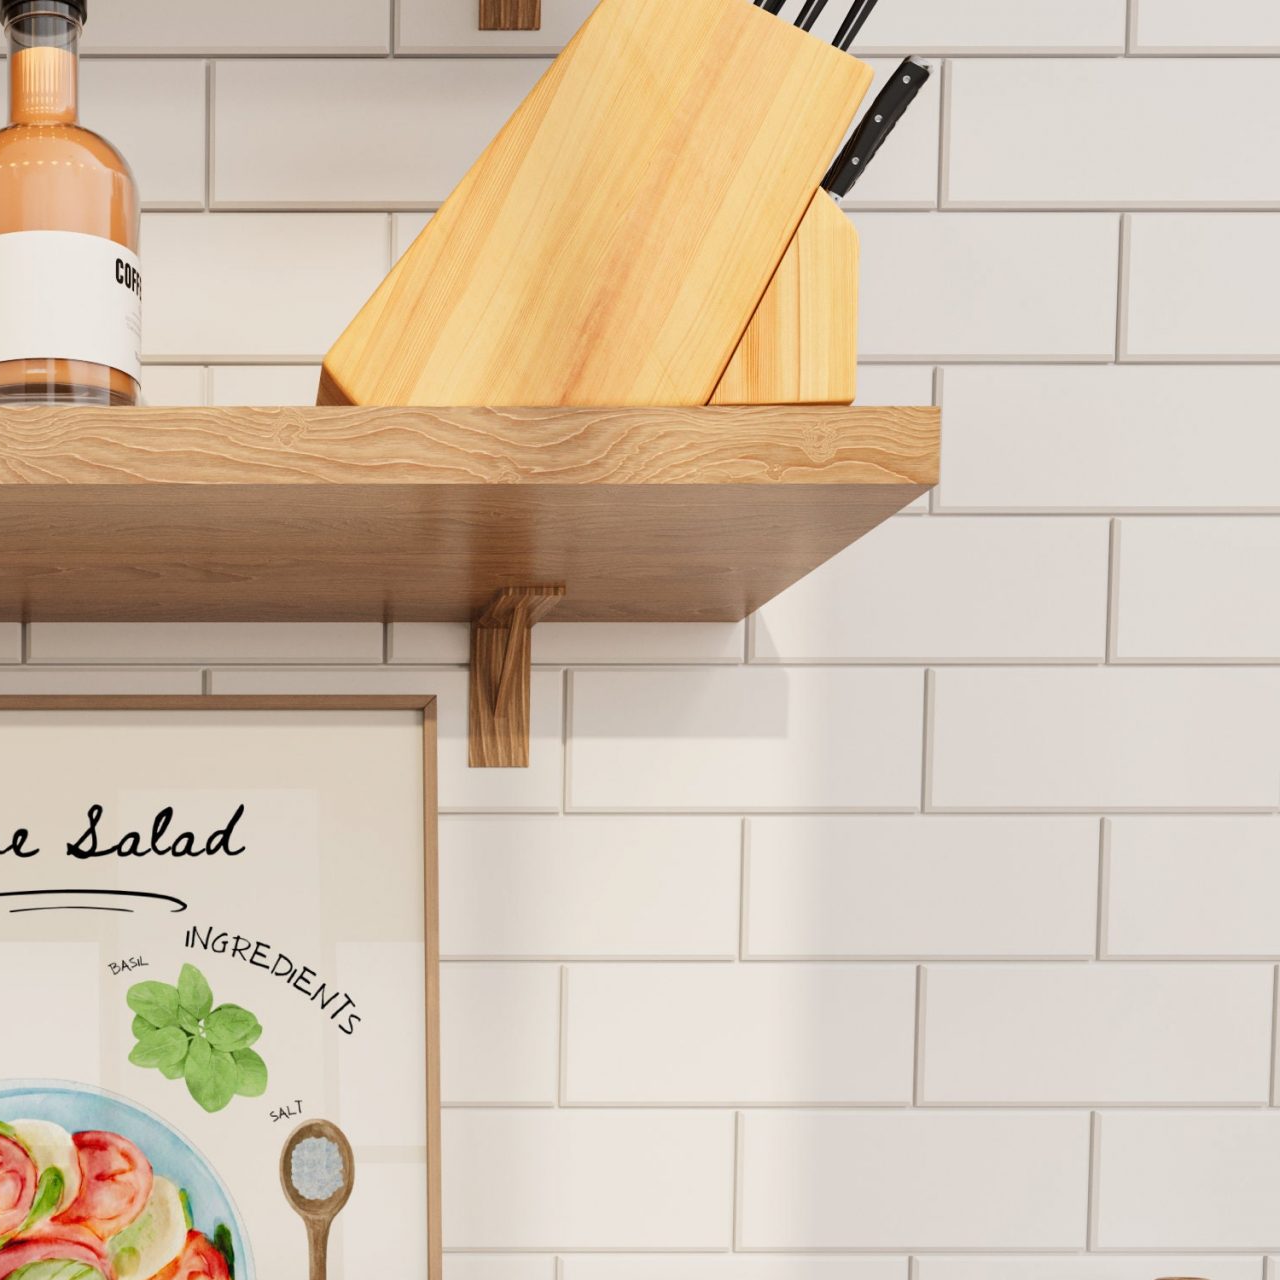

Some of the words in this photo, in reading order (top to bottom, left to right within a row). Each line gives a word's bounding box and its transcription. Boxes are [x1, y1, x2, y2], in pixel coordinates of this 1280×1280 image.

[66, 804, 246, 860] Salad
[108, 956, 149, 976] BASIL
[184, 926, 362, 1036] INGREDIENTS
[269, 1099, 303, 1122] SALT
